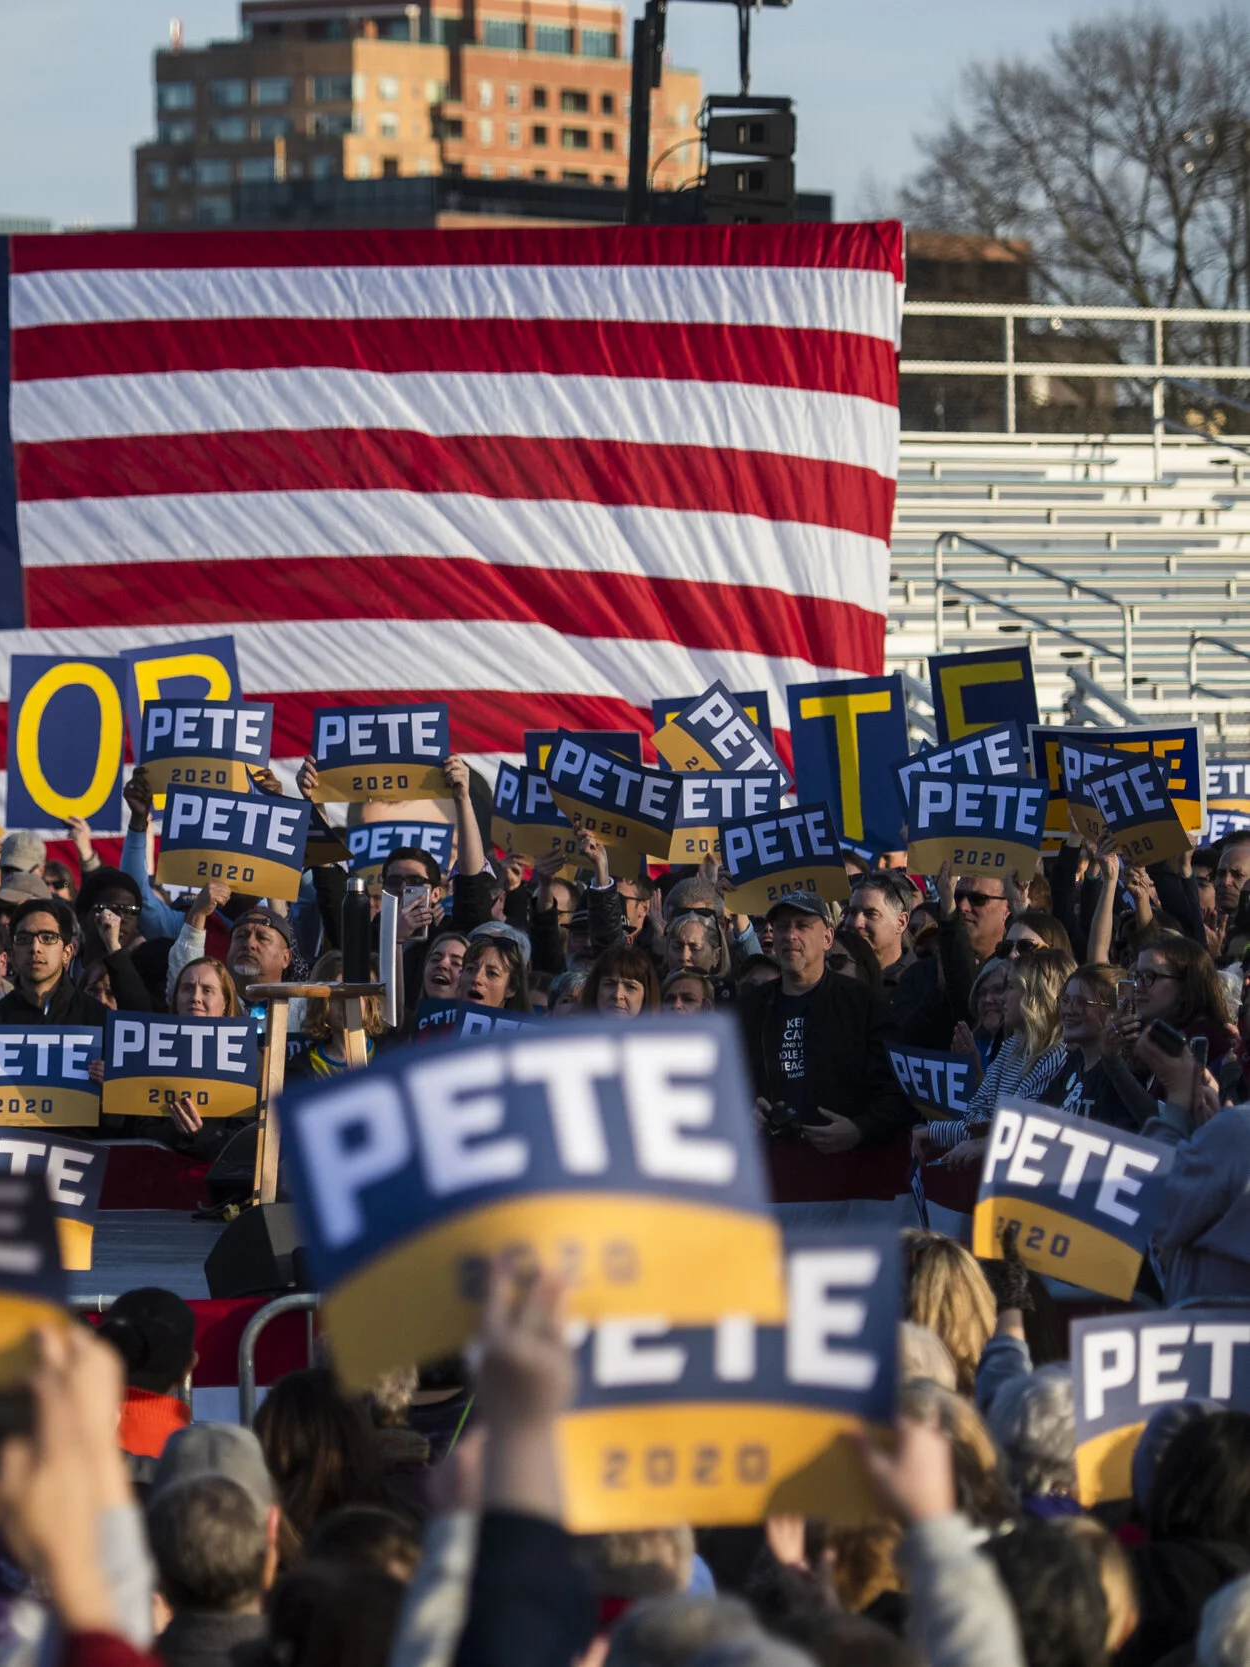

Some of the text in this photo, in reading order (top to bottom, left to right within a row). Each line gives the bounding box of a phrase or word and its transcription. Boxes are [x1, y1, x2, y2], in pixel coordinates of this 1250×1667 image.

[146, 707, 266, 756] PETE
[317, 711, 441, 761] PETE
[687, 691, 787, 787] PET
[171, 768, 227, 785] 2020
[353, 775, 408, 791] 2020
[551, 738, 674, 820] PETE
[683, 778, 772, 819] ETE
[1090, 762, 1165, 824] ETE
[169, 793, 302, 856] PETE
[573, 812, 628, 838] 2020
[918, 780, 1043, 836] PETE
[349, 826, 448, 867] PETE
[685, 839, 721, 852] 202
[724, 811, 834, 877] PETE
[953, 849, 1006, 867] 2020
[197, 861, 255, 882] 2020
[113, 1019, 249, 1073] PETE
[149, 1088, 209, 1105] 2020
[889, 1051, 969, 1113] PETE
[295, 1034, 738, 1251] PETE
[984, 1109, 1160, 1227] PETE
